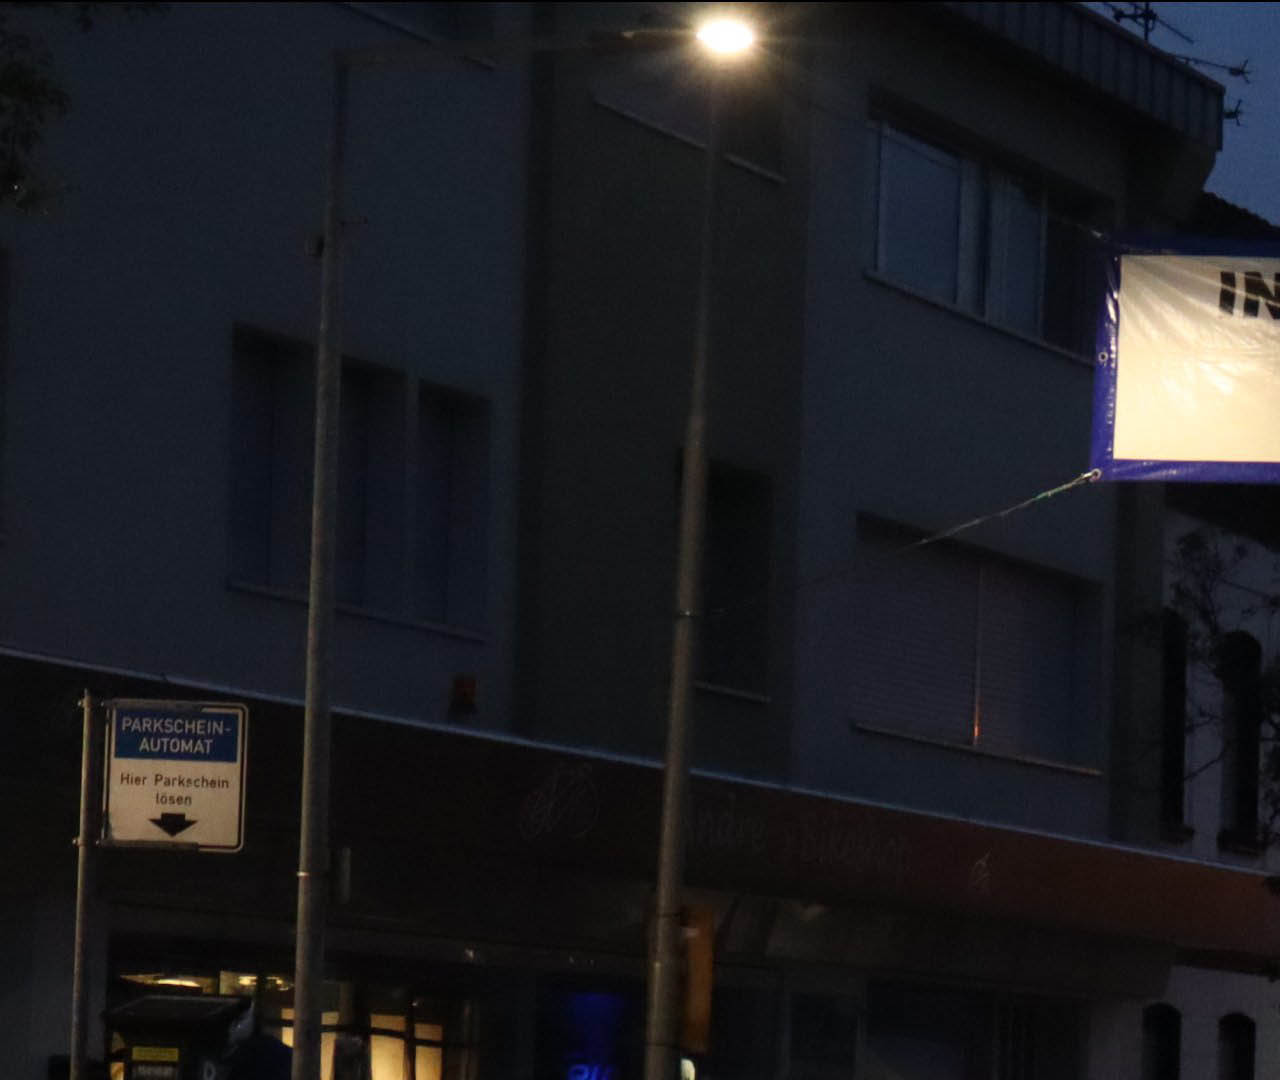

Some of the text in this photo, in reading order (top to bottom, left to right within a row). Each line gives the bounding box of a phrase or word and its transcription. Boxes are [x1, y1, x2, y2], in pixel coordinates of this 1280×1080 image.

[122, 716, 232, 735] PARKSCHEIN-
[139, 737, 214, 754] AUTOMAT
[120, 771, 230, 790] Hier Parkschein
[155, 793, 193, 807] lösen
